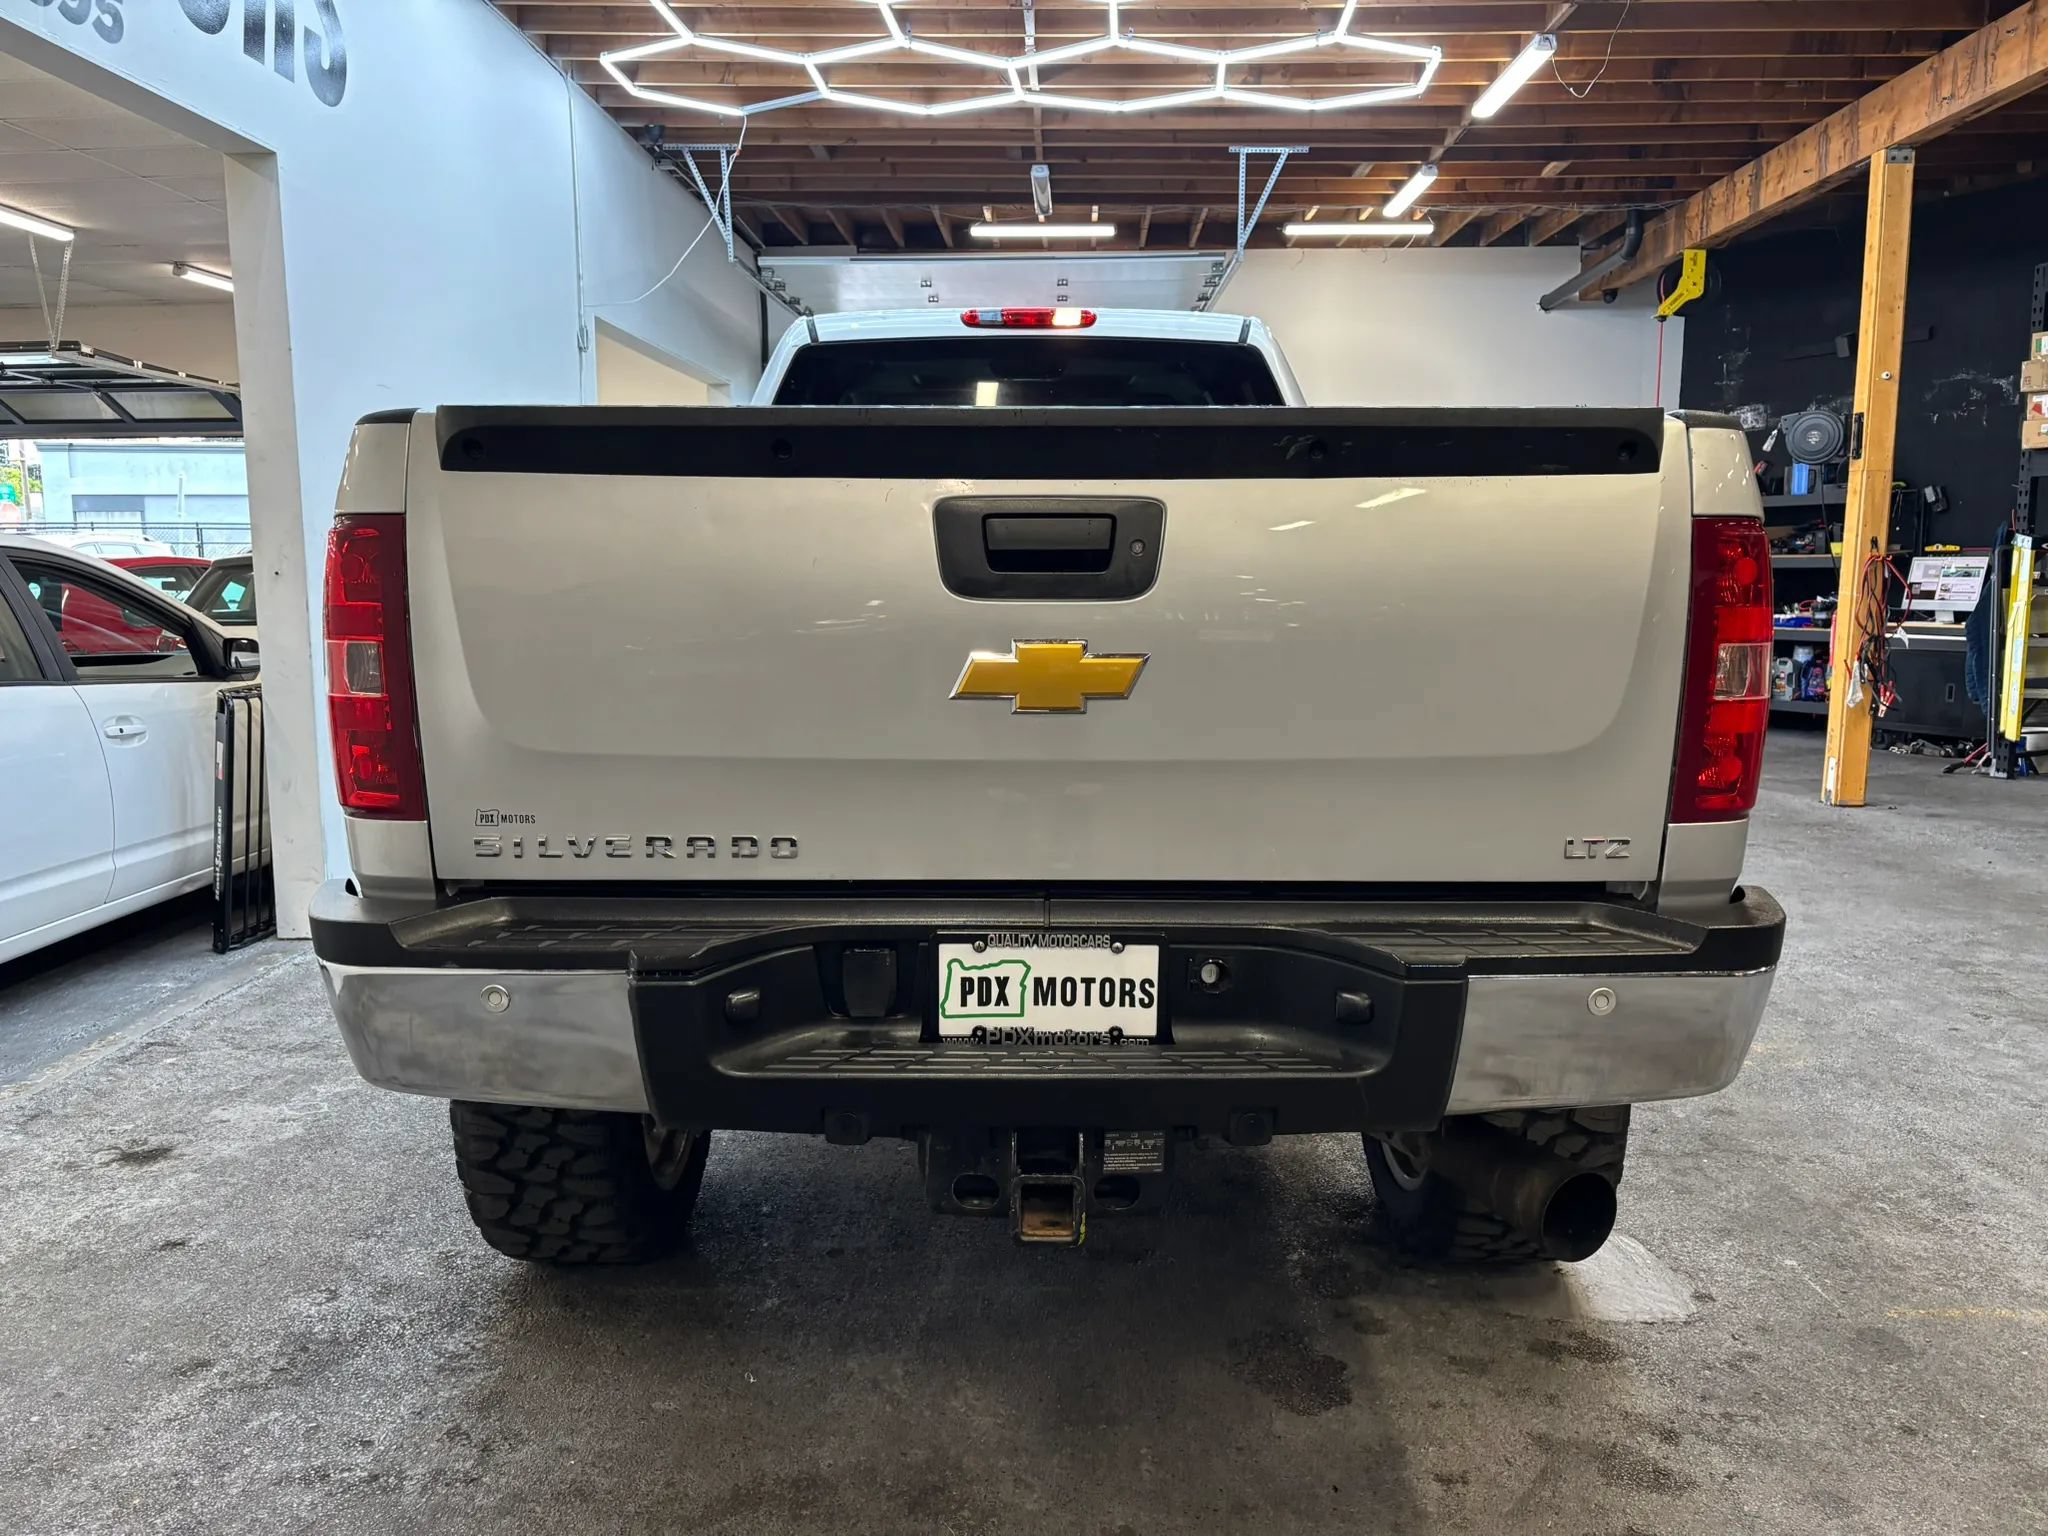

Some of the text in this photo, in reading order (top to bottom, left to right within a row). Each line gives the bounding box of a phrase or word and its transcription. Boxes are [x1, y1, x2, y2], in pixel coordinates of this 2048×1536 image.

[480, 814, 536, 824] PDX MOTORS
[474, 834, 799, 859] SILVERADO
[1564, 837, 1631, 859] LTZ
[987, 934, 1111, 949] QUALITY MOTORCARS
[960, 976, 1155, 1009] PDX MOTORS
